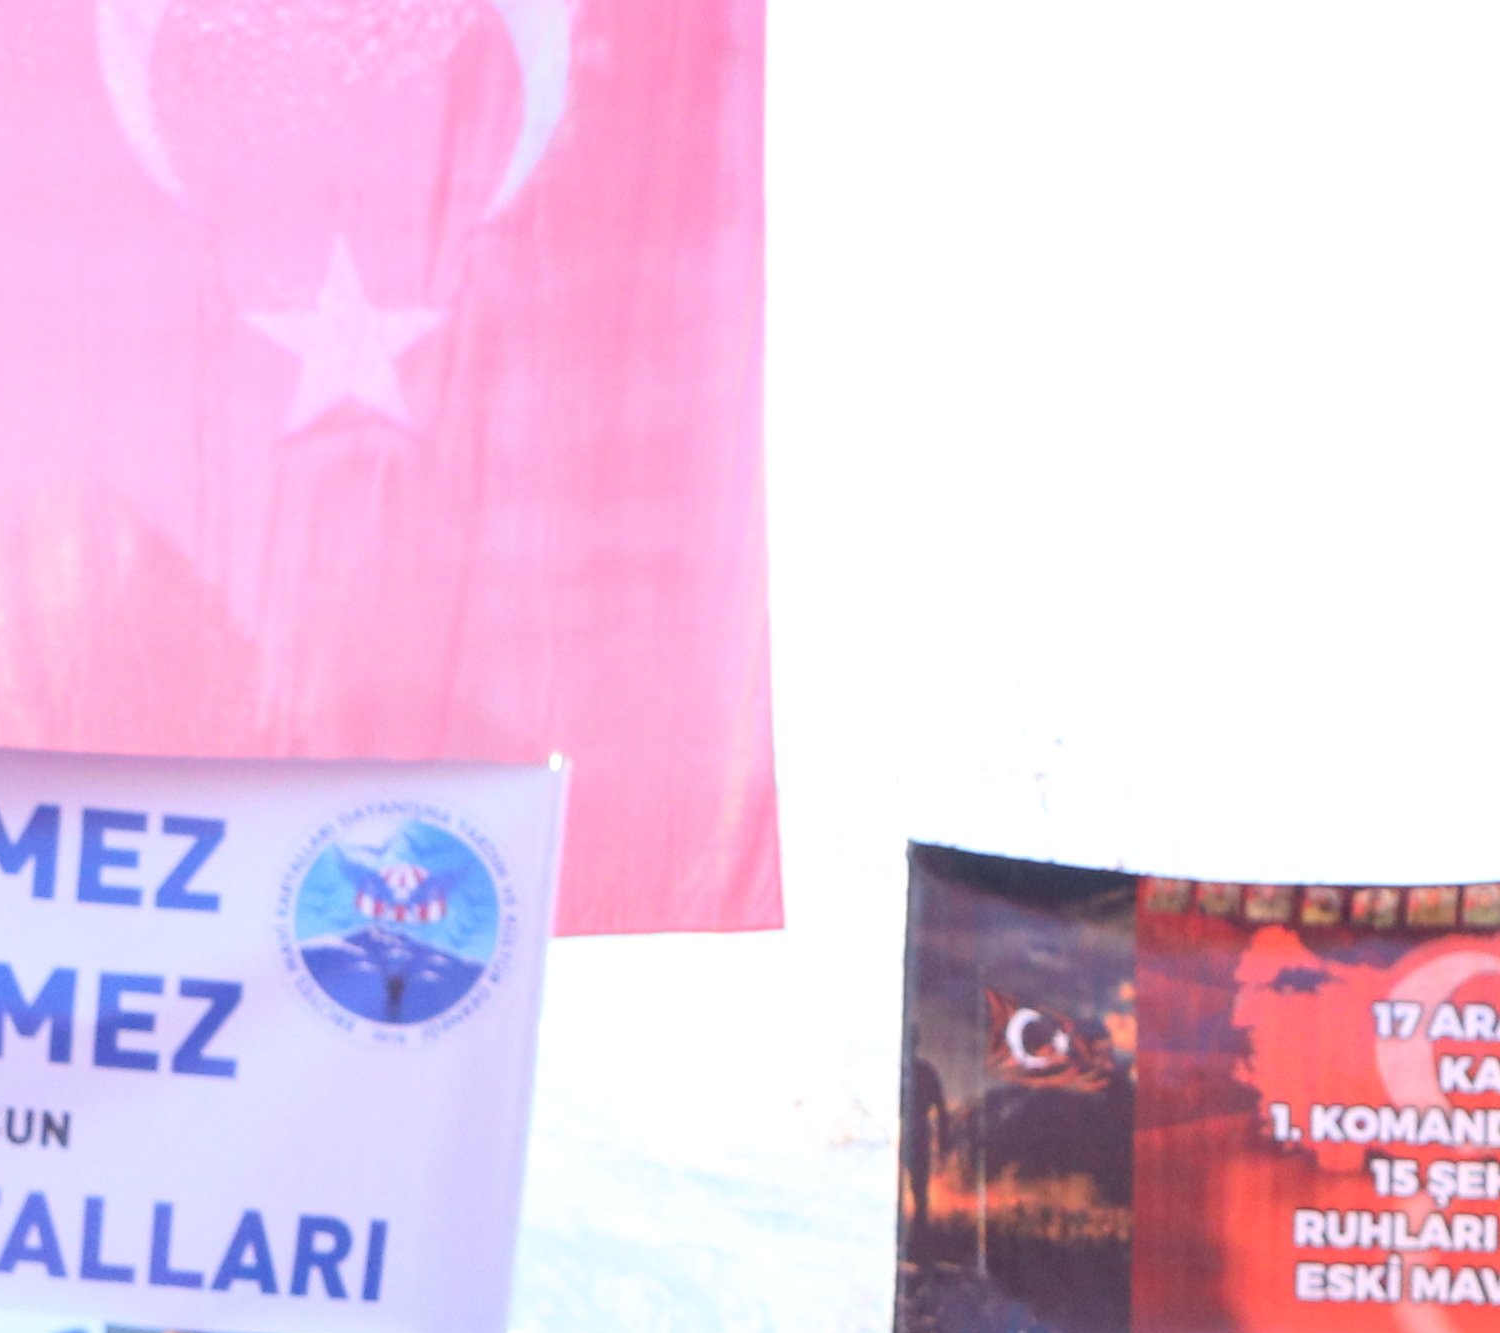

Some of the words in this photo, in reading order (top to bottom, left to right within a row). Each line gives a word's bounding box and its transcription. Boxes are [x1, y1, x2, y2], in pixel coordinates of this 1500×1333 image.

[1373, 1001, 1420, 1039] 17
[1270, 1104, 1299, 1142] 1.
[1371, 1158, 1419, 1196] 15
[1294, 1209, 1498, 1252] RUHLARI
[1296, 1255, 1399, 1301] ESKİ
